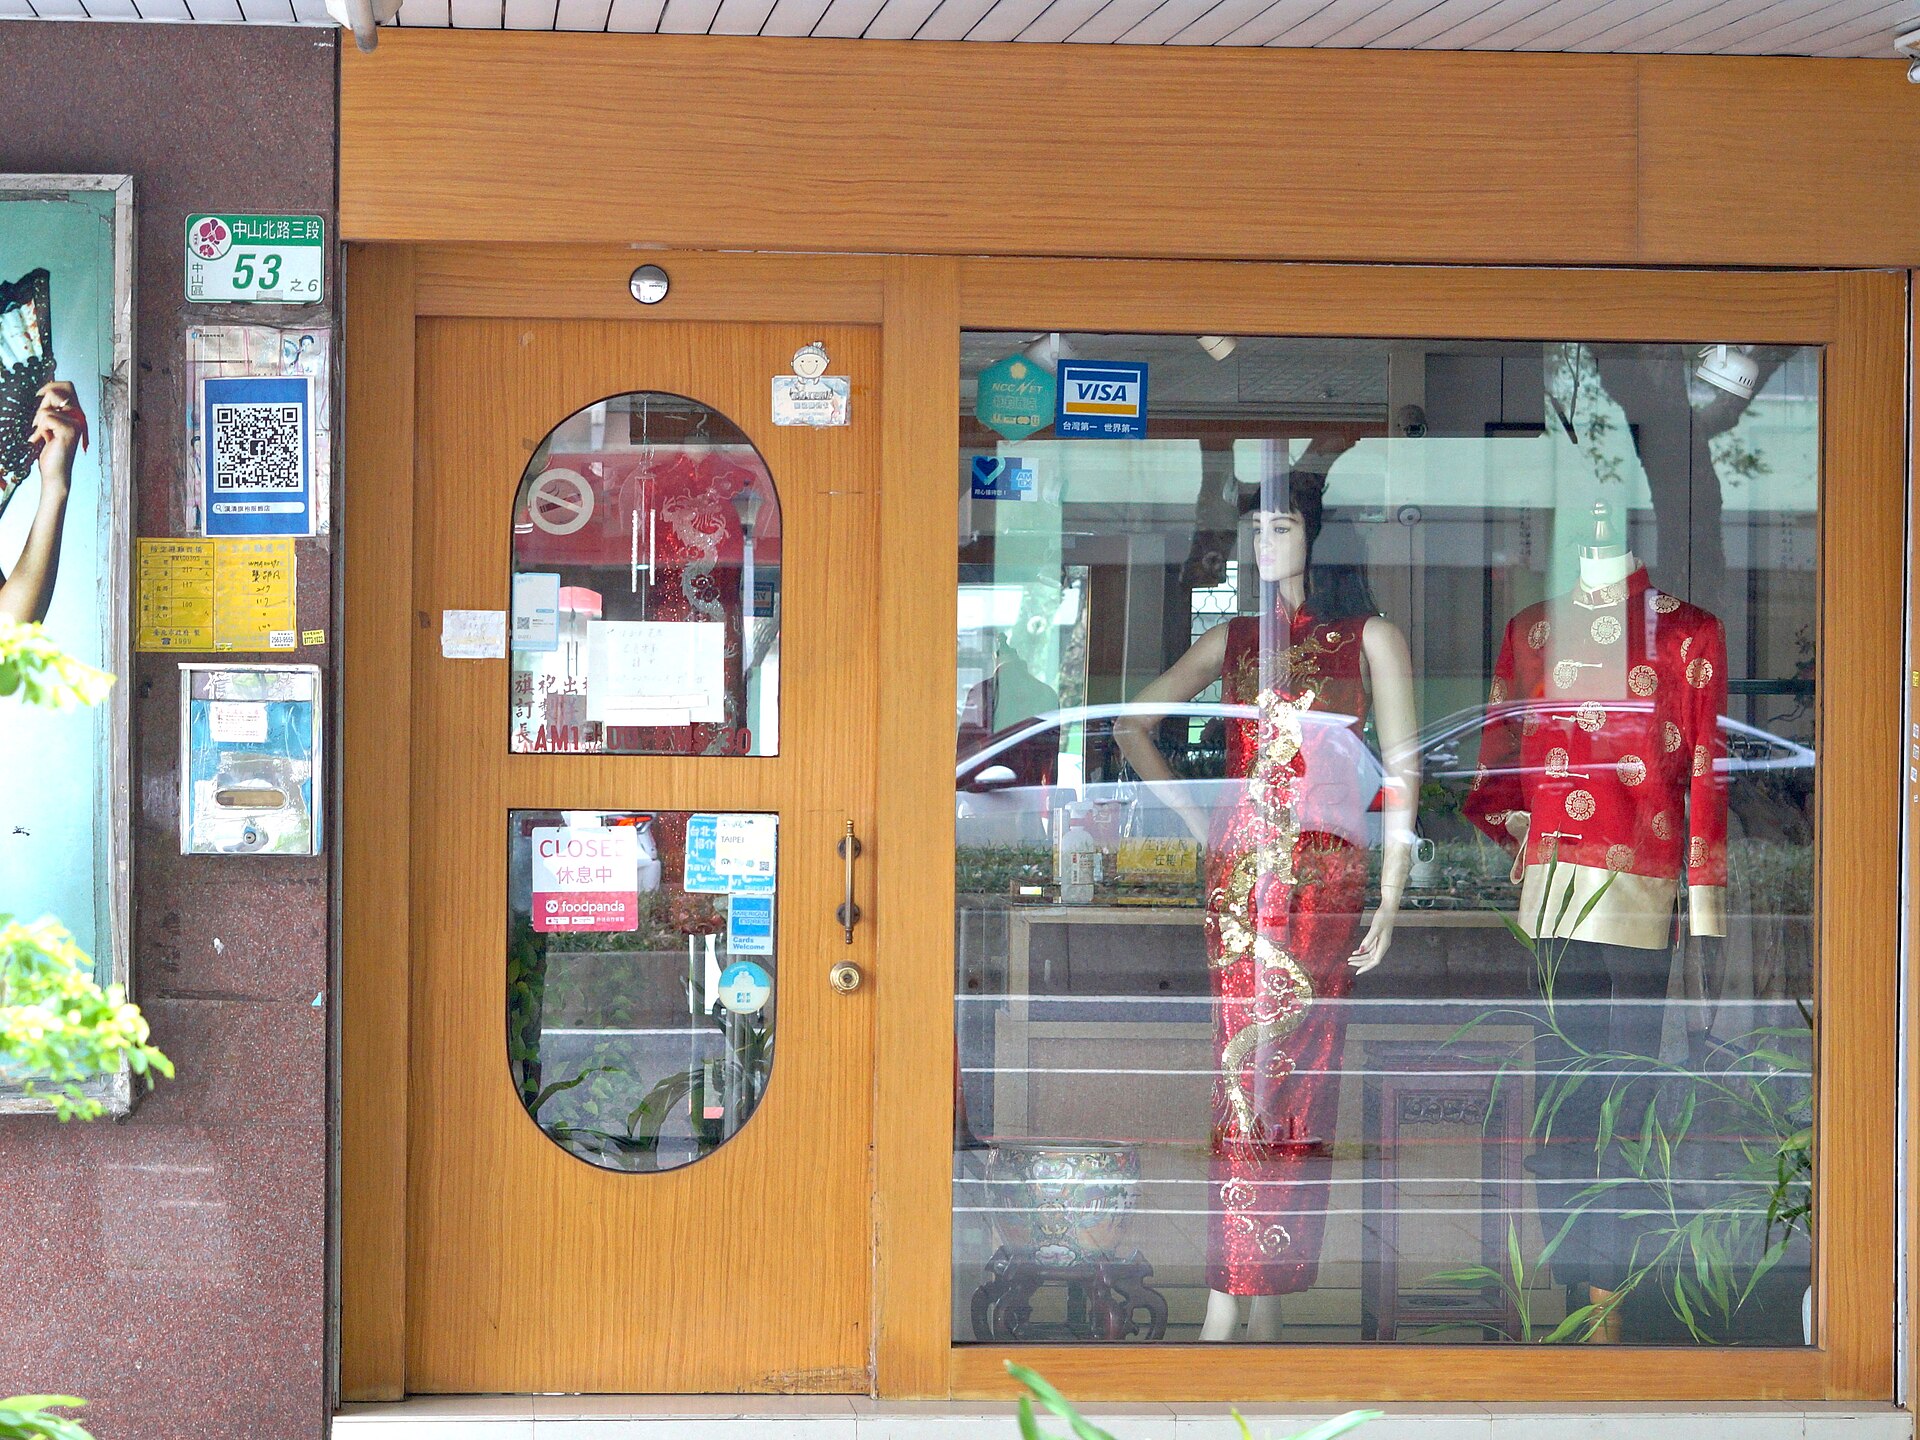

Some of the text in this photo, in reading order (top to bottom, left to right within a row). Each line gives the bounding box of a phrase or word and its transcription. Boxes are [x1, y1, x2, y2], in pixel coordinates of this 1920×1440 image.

[233, 220, 320, 240] 中山北路三段
[191, 262, 204, 296] 中山區
[232, 253, 283, 290] 53
[1076, 383, 1127, 402] VISA
[1063, 421, 1139, 433] 台灣第一 世界第一
[515, 673, 587, 696] 旗袍出
[556, 866, 612, 885] 休息中
[561, 900, 625, 914] foodpanda
